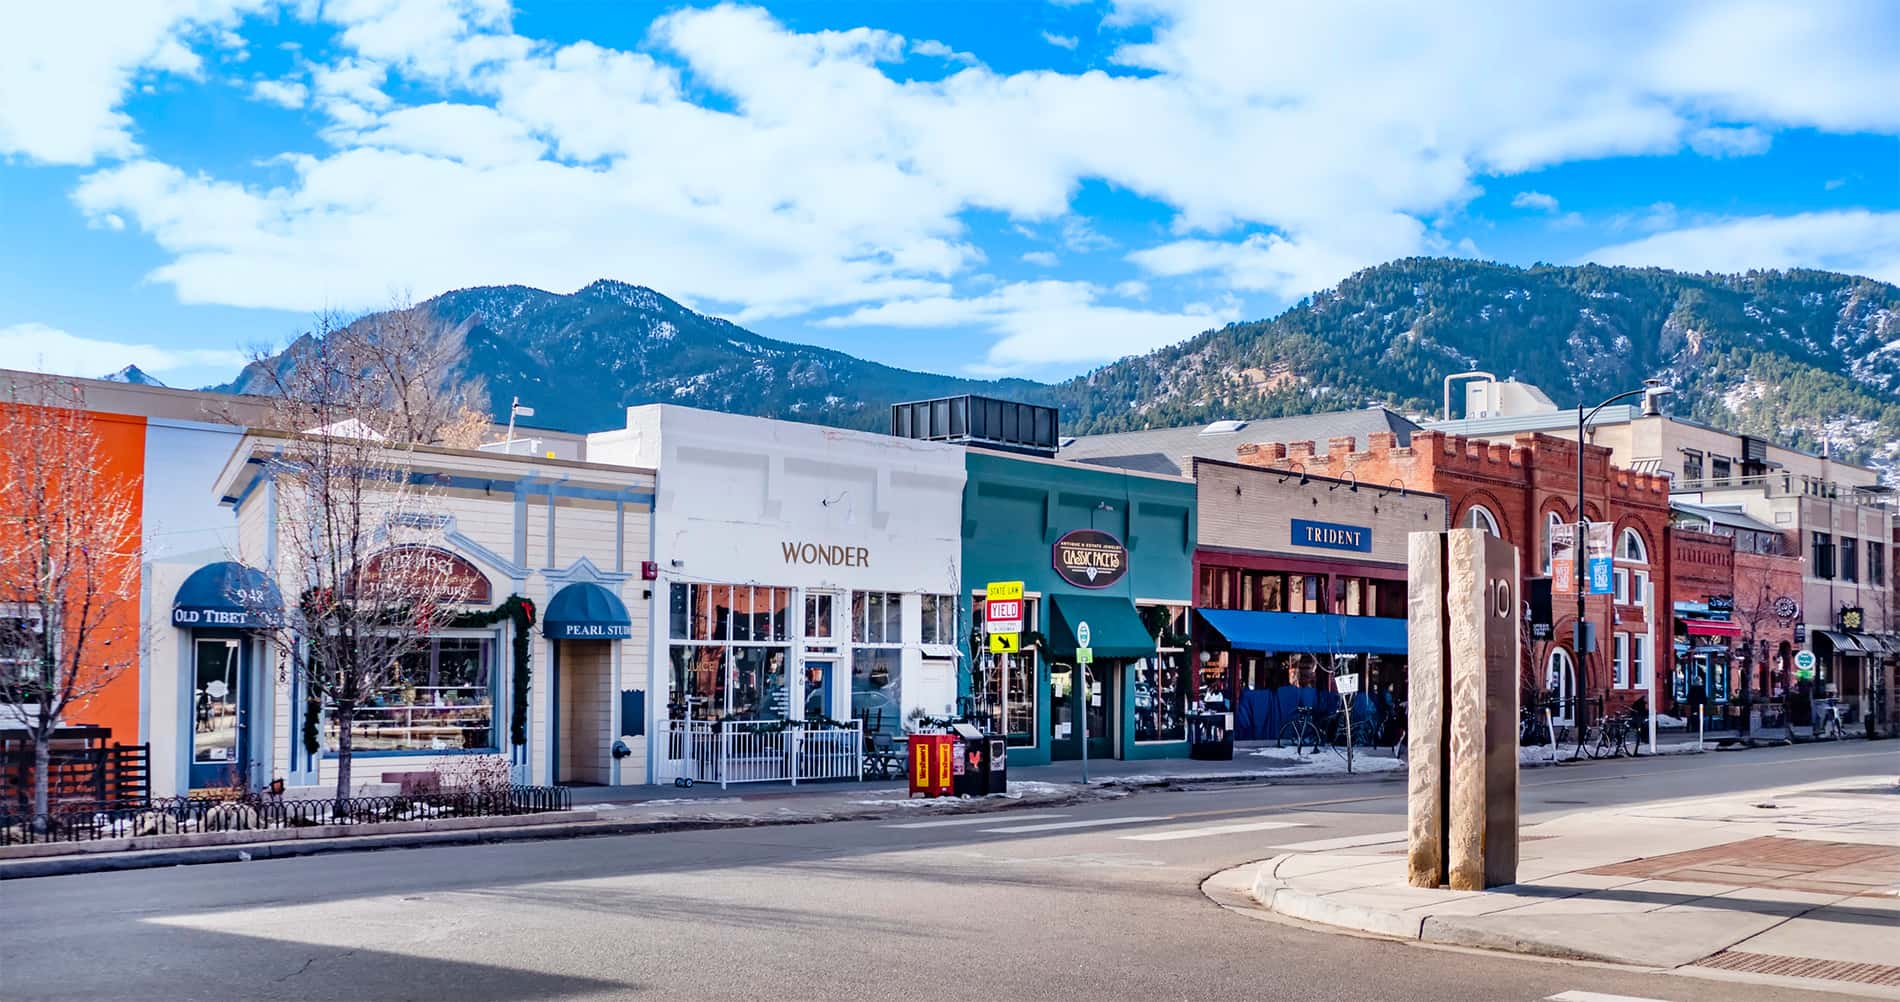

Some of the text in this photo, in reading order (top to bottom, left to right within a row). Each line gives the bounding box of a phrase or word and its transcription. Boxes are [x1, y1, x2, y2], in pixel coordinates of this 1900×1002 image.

[1305, 526, 1361, 546] TRIDENT
[781, 541, 869, 568] WONDER
[1063, 550, 1092, 566] CLASSIC
[236, 588, 264, 603] 948
[990, 586, 1018, 595] STATE LAW
[1489, 578, 1510, 618] 10
[175, 609, 200, 623] OLD
[203, 609, 248, 624] TIBET
[992, 604, 1017, 617] YIELD
[566, 625, 606, 635] PEARL
[278, 648, 288, 684] 948
[687, 660, 714, 672] JUICE
